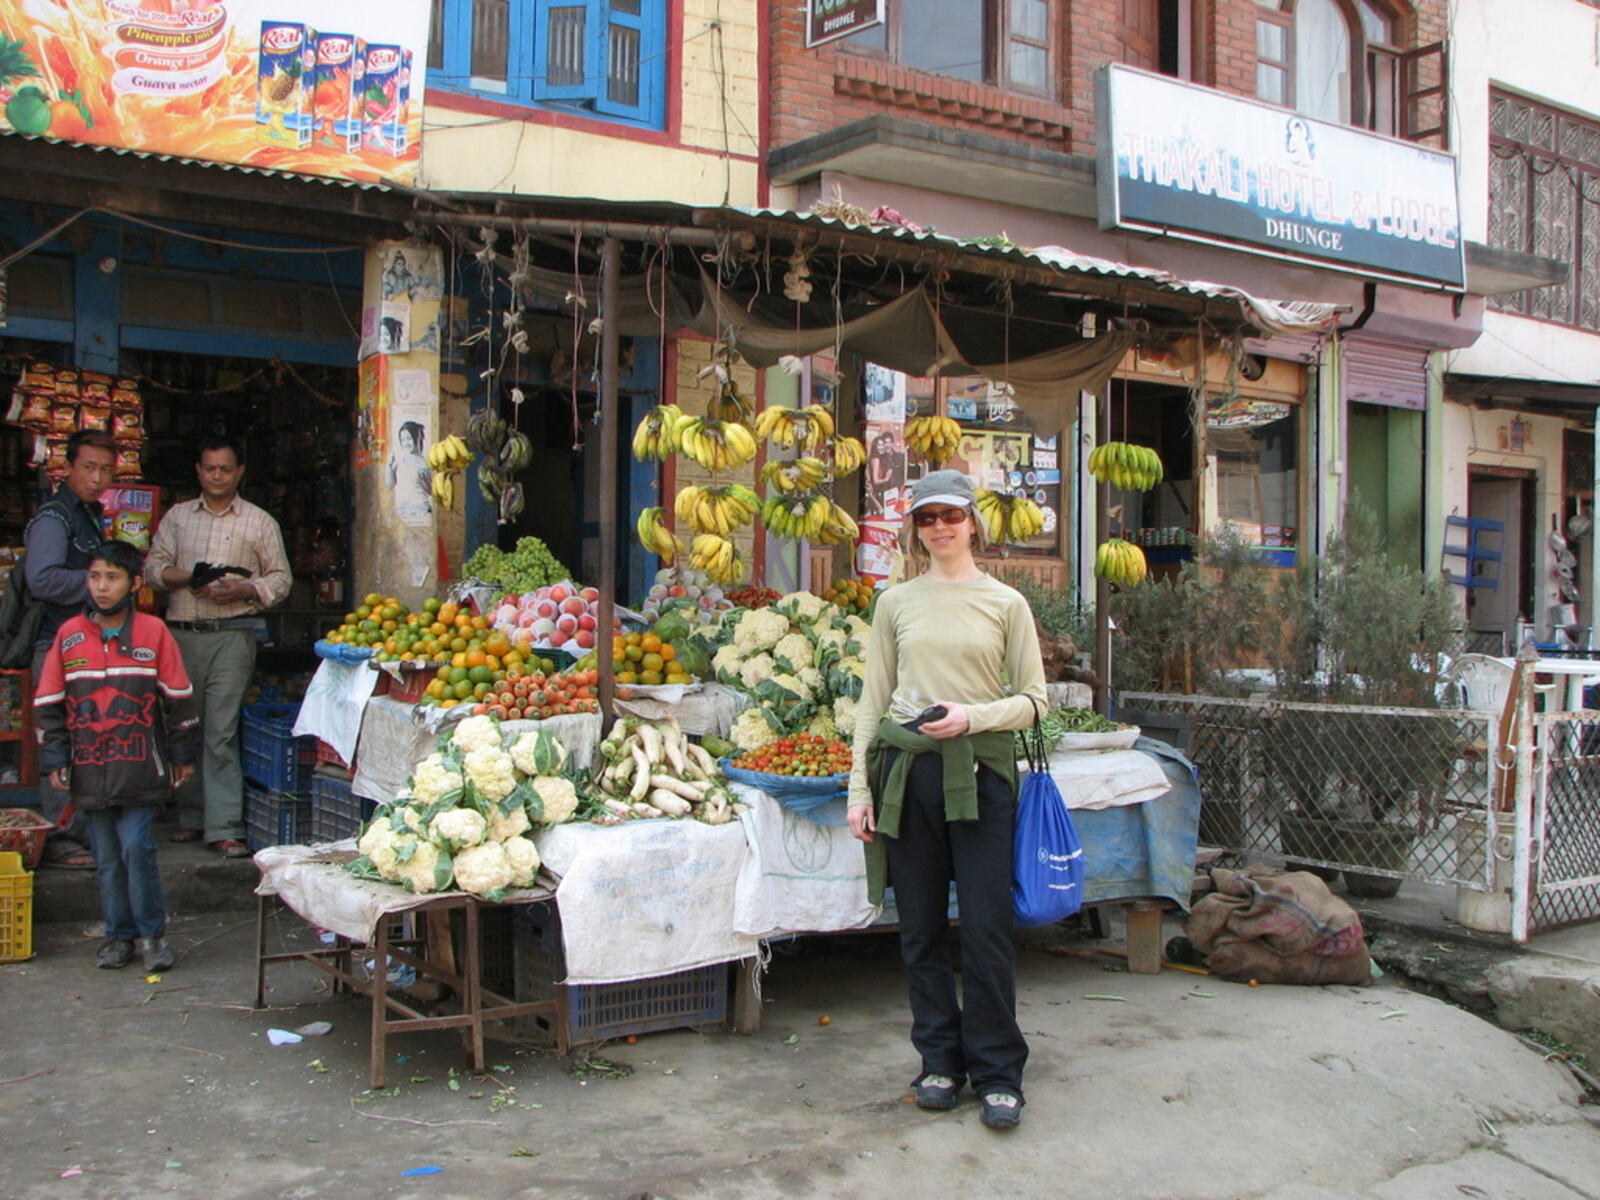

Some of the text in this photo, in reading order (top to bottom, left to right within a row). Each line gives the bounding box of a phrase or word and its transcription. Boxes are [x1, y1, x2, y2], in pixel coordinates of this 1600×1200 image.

[126, 26, 214, 47] Pineapple juice
[134, 52, 208, 71] Orange juice
[131, 75, 208, 90] Guava nectar
[1122, 131, 1459, 250] THAKALI HOTEL & LODGE
[1265, 217, 1345, 252] DHUNGE
